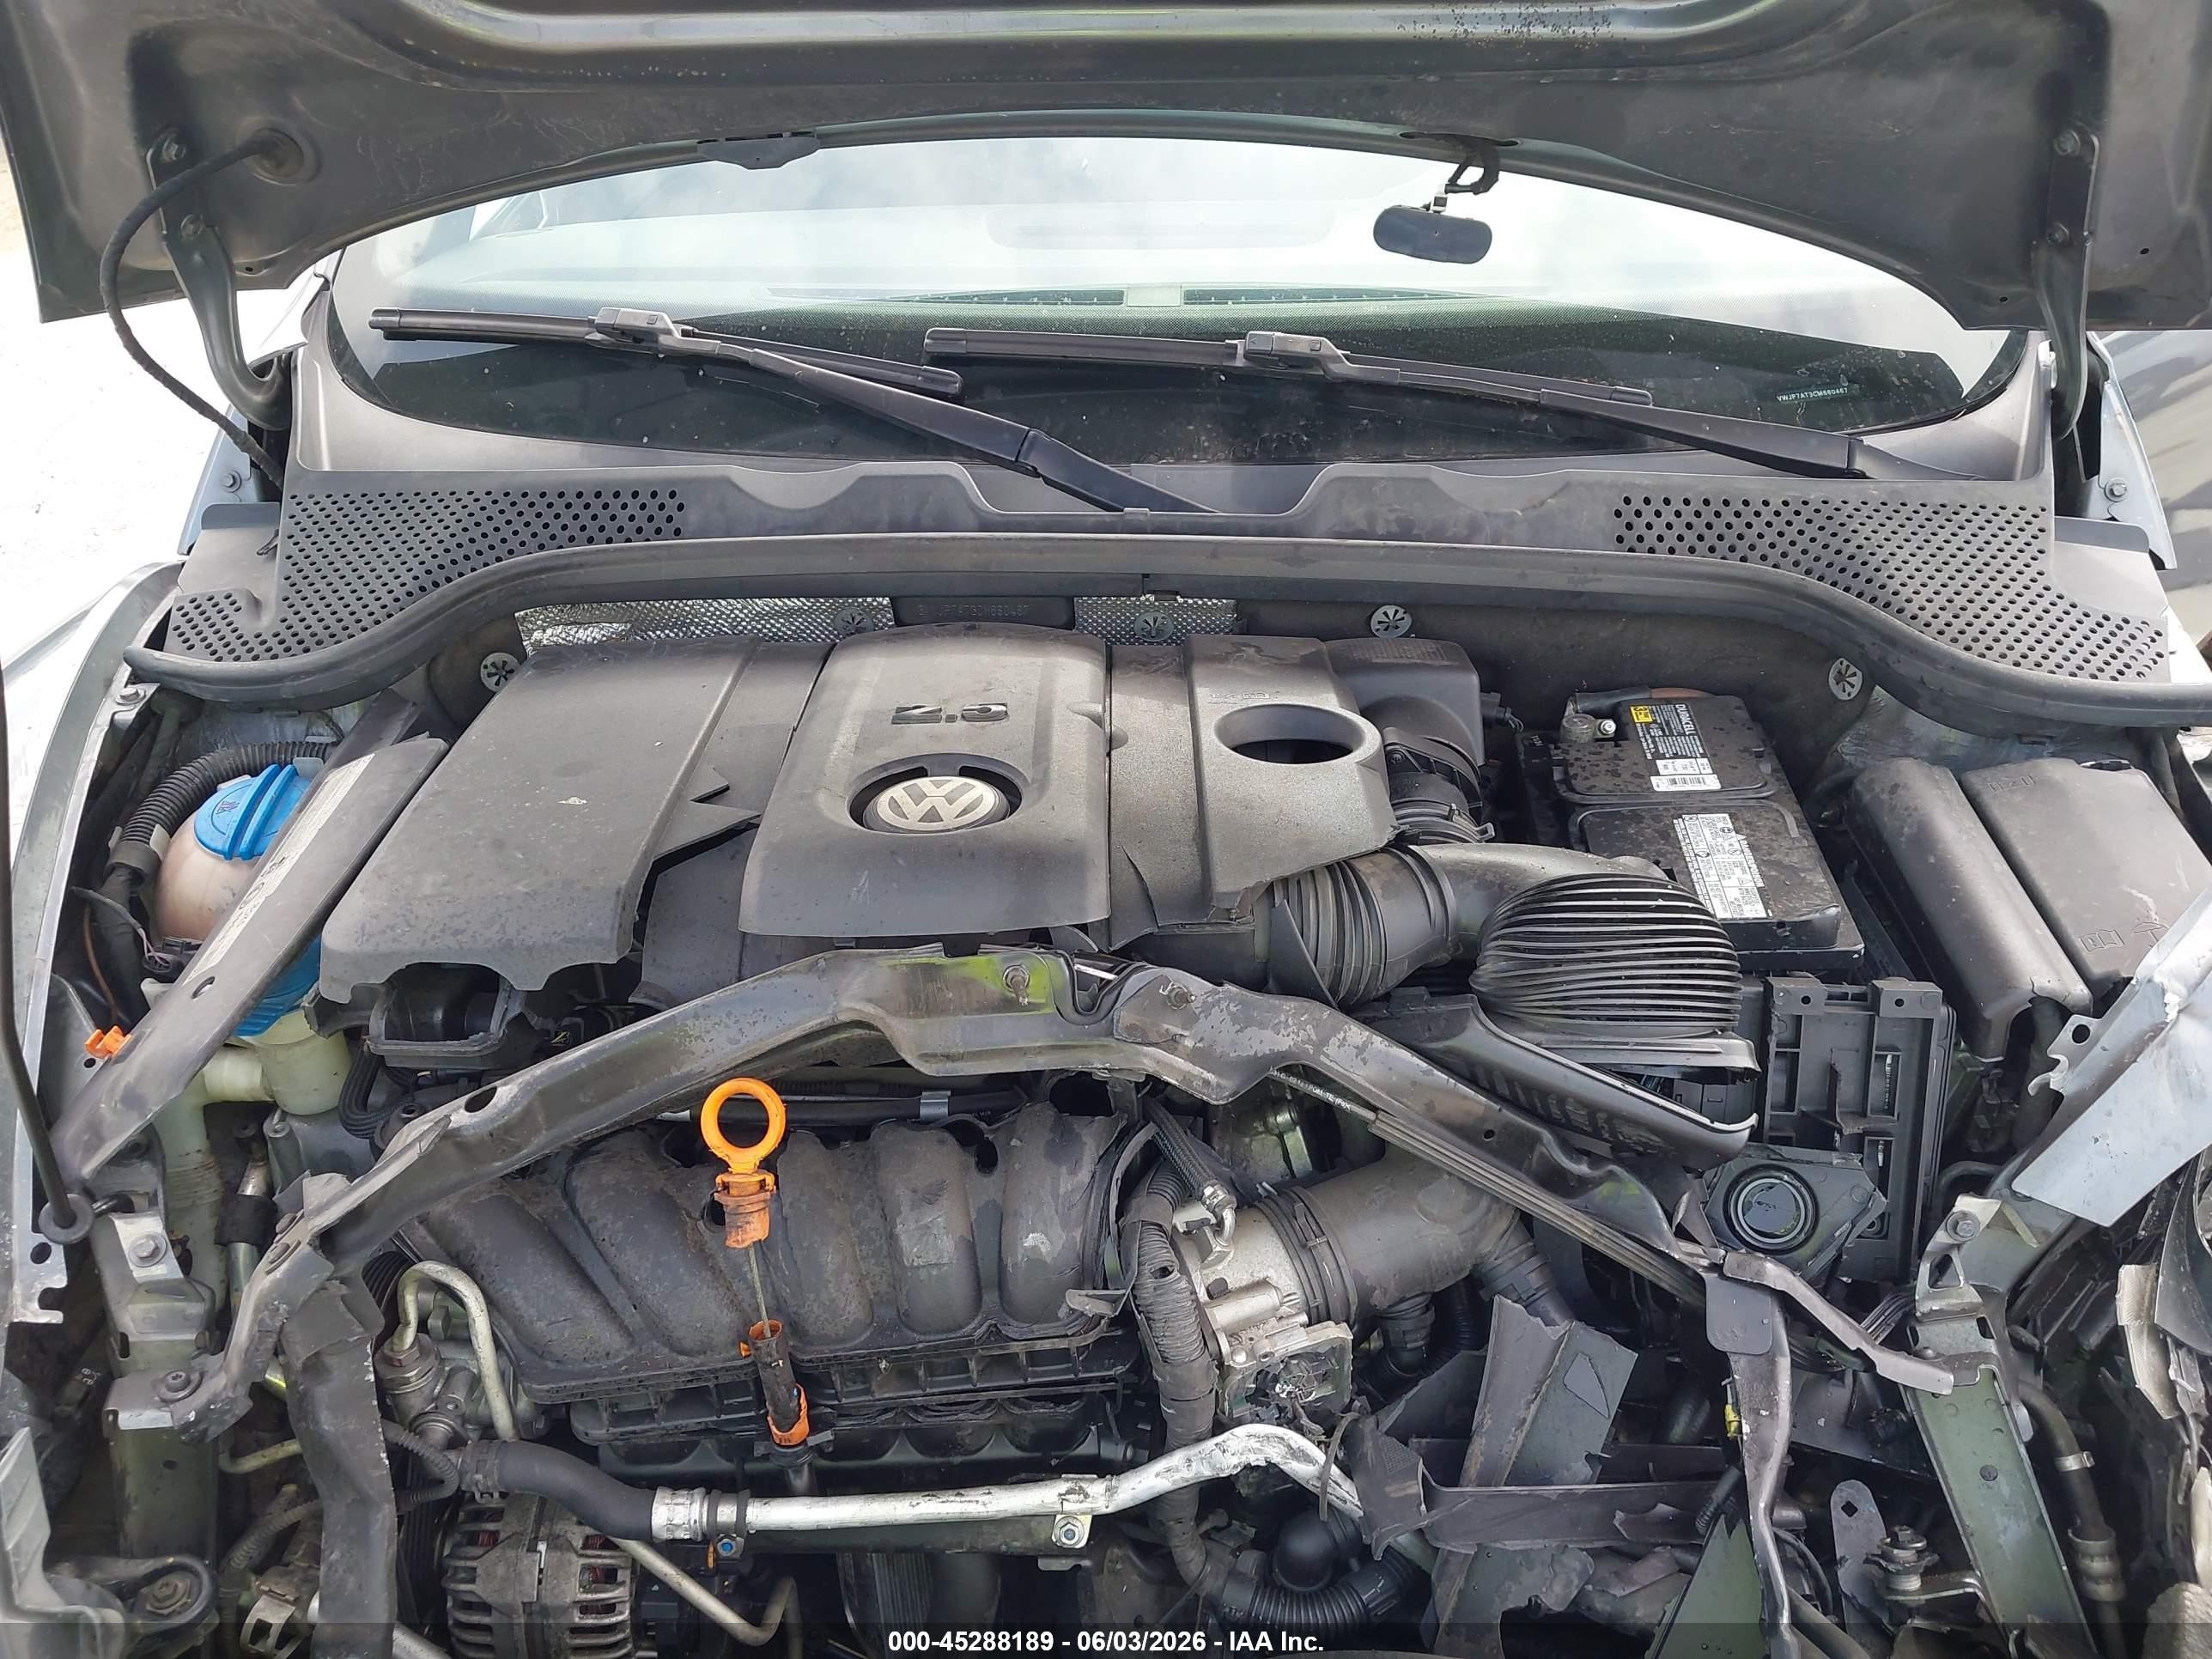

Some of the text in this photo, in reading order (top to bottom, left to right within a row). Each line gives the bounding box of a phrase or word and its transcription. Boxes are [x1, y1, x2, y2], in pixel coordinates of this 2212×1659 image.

[891, 702, 1008, 725] 2.5
[1675, 704, 1697, 735] DURACELL
[877, 776, 995, 830] VW
